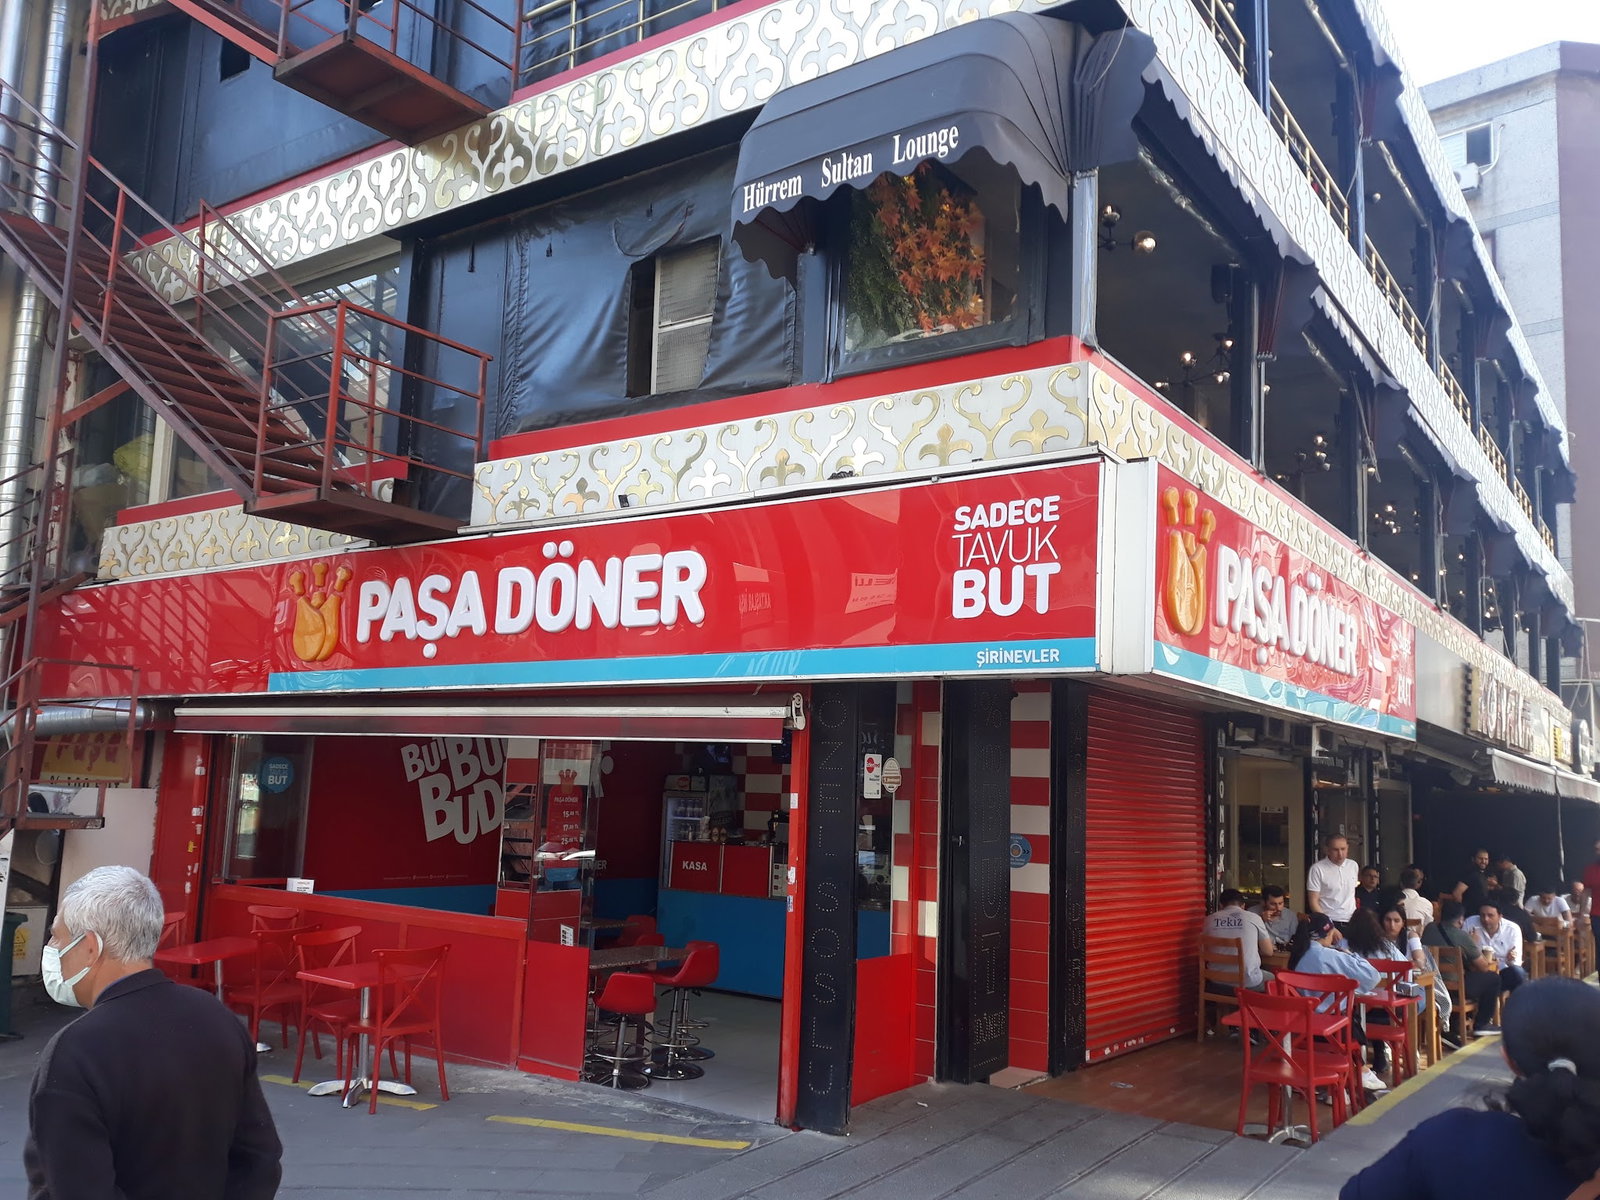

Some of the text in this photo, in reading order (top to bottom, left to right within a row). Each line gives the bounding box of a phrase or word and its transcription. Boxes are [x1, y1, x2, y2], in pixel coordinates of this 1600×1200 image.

[742, 125, 959, 213] Hürrem Sultan Lounge
[953, 495, 1060, 532] SADECE
[951, 524, 1059, 568] TAVUK
[356, 540, 707, 659] PAŞA DÖNER
[952, 562, 1061, 619] BUT
[1216, 544, 1358, 677] PAŞA DÖNER
[976, 648, 1060, 668] ŞİRİNEVLER
[267, 775, 288, 785] BUT
[682, 860, 707, 871] KASA
